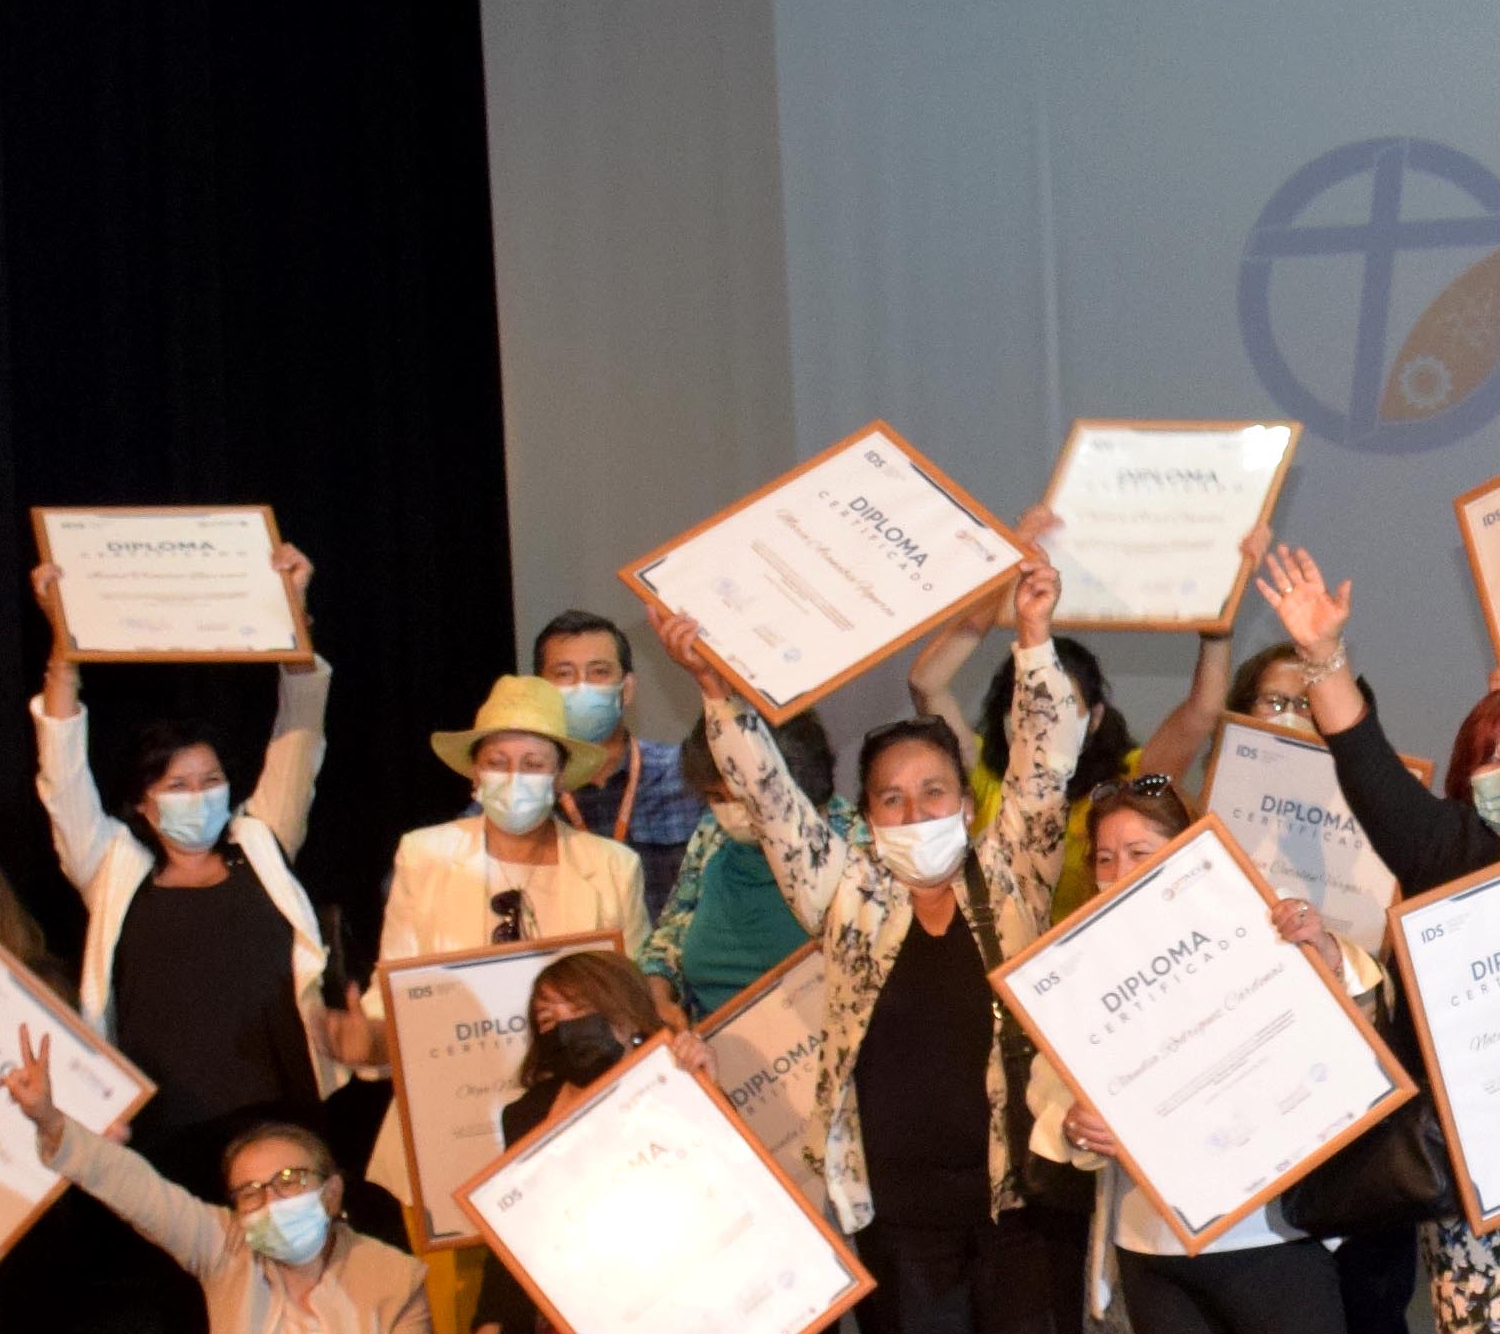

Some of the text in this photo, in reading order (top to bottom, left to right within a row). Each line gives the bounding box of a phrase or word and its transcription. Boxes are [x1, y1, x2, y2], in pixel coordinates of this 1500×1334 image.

[847, 495, 930, 568] DIPLOMA
[1235, 744, 1259, 762] IDS
[1260, 793, 1358, 834] DIPLOMA
[1420, 923, 1445, 945] IDS
[1032, 970, 1061, 997] IDS
[1100, 929, 1211, 1013] DIPLOMA
[408, 986, 433, 1000] IDS
[1088, 926, 1248, 1046] CERTIFICADO
[455, 1015, 528, 1042] DIPLO
[729, 1034, 822, 1107] DIPLOMA
[496, 1187, 524, 1213] IDS
